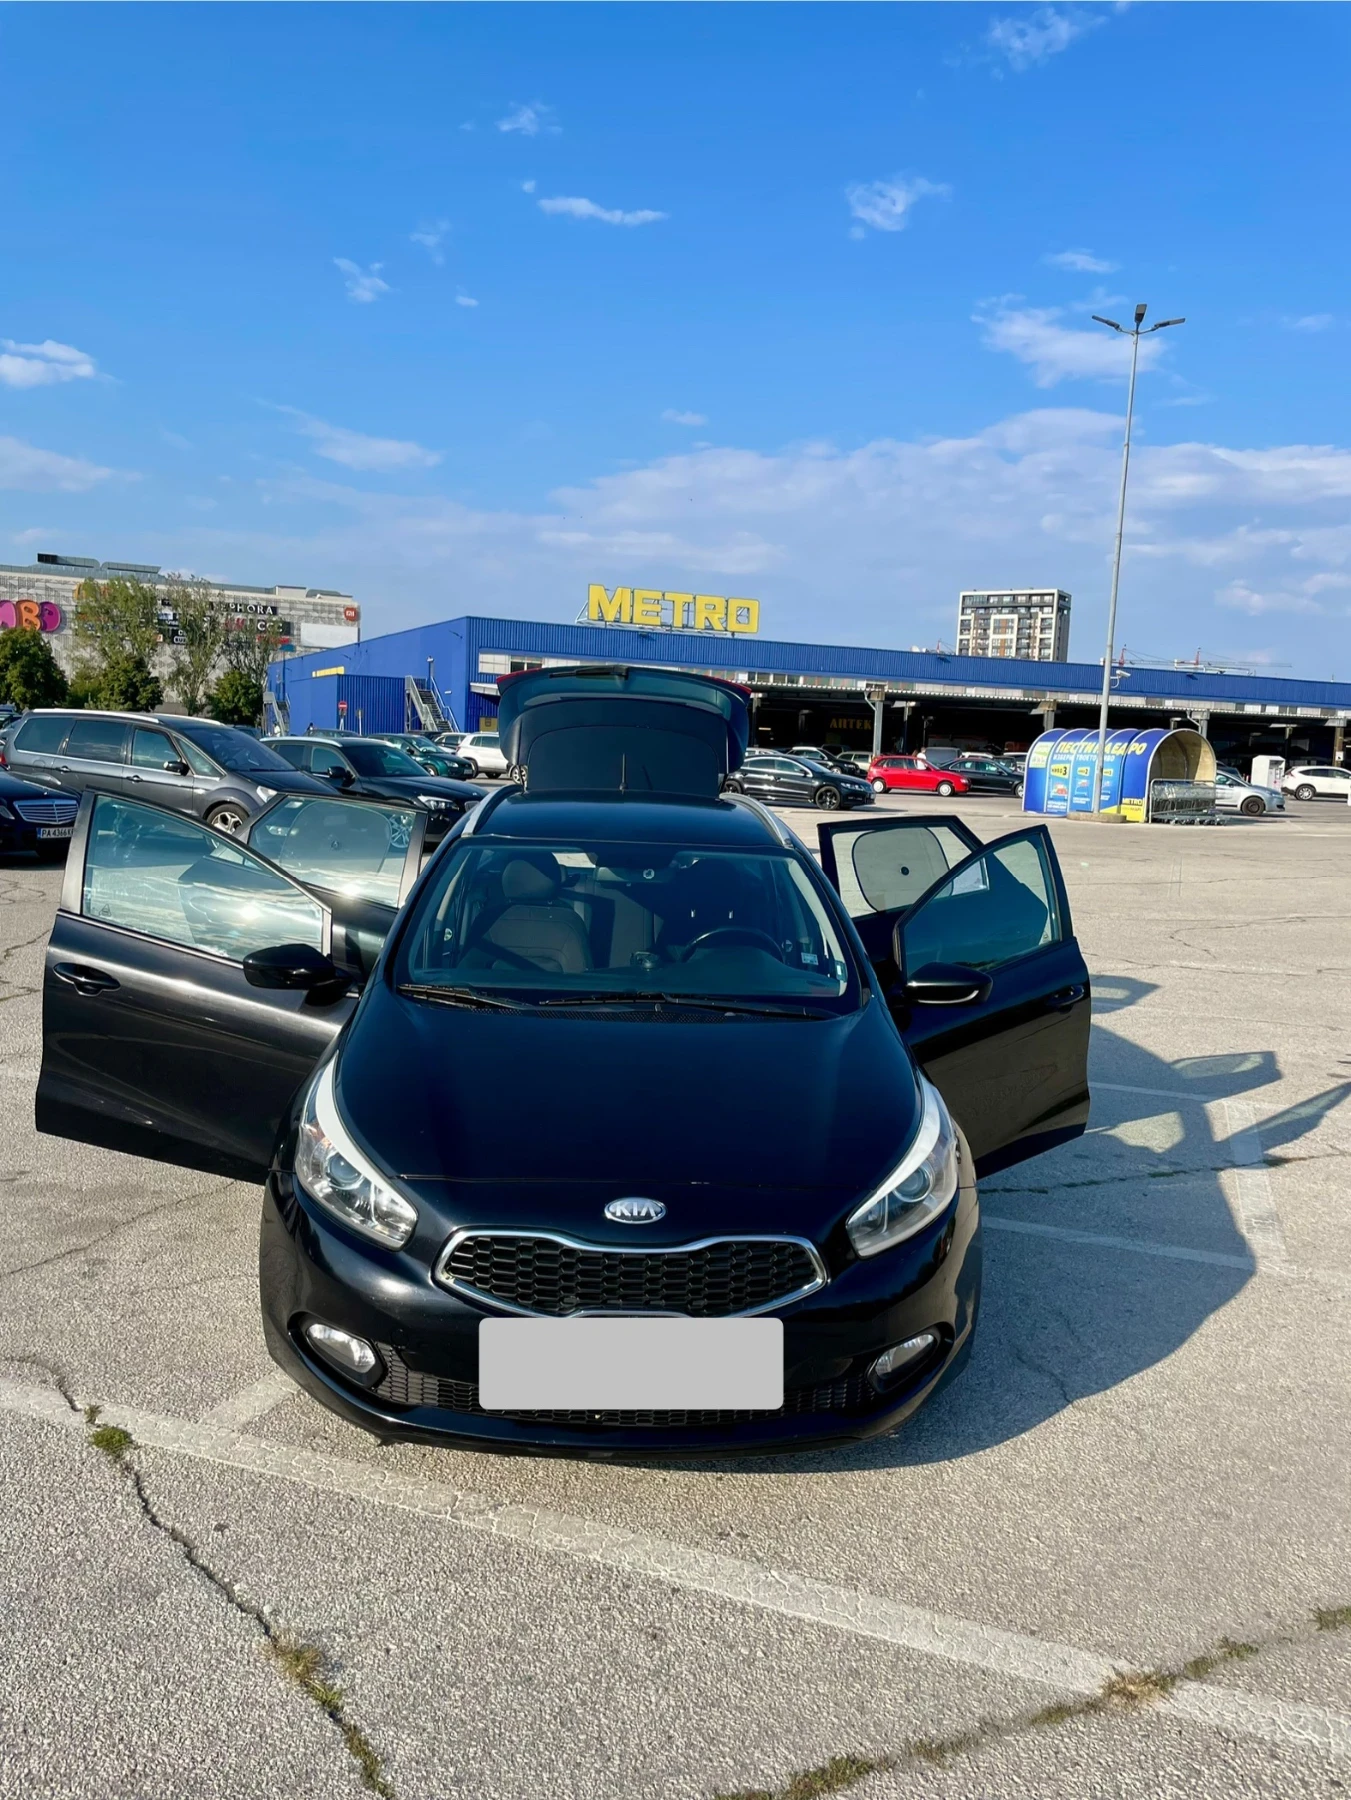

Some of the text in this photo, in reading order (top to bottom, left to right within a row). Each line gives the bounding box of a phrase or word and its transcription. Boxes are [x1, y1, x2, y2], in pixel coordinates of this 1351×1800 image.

[588, 583, 760, 634] METRO
[829, 717, 872, 731] АПТЕК
[1062, 766, 1068, 776] 3
[615, 1202, 656, 1217] KIA
